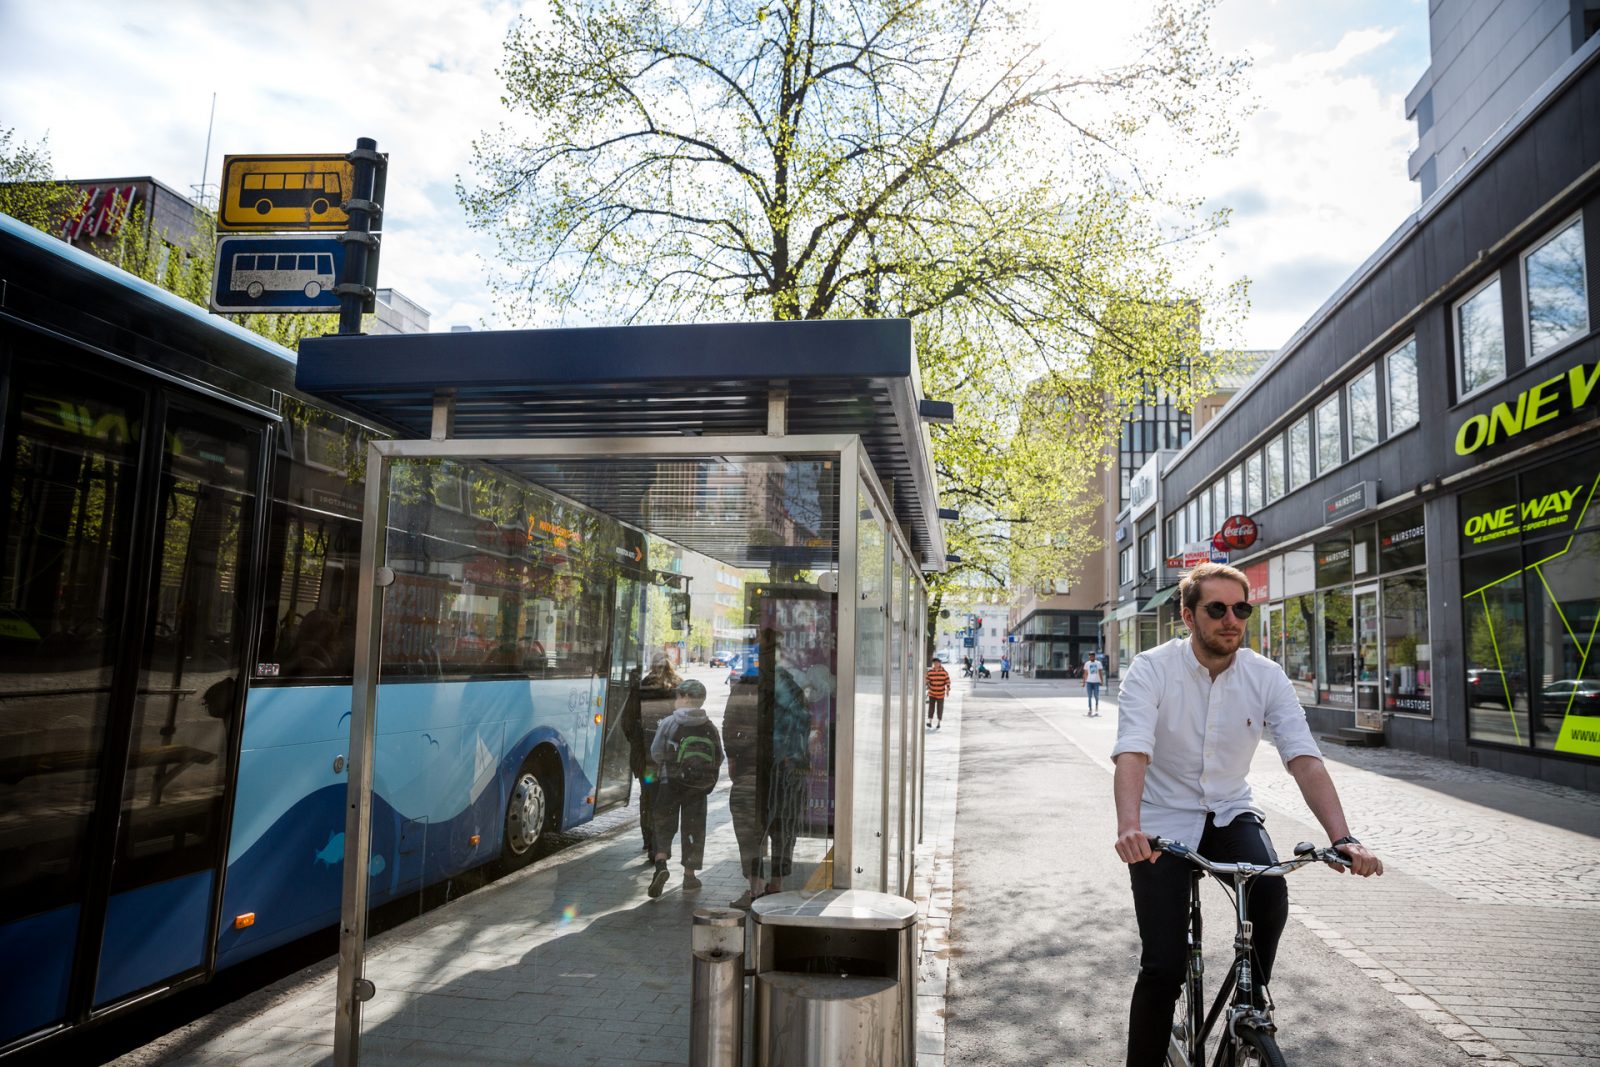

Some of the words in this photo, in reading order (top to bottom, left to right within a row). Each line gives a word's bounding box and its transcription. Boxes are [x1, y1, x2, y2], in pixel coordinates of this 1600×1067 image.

[1336, 491, 1361, 507] HAIRSTORE
[1464, 504, 1517, 537] ONE
[1521, 485, 1583, 521] WAY
[1392, 526, 1424, 542] HAIRSTORE
[1330, 694, 1354, 704] HAIRSTORE
[1397, 699, 1430, 710] HAIRSTORE
[1571, 729, 1600, 744] WWW.
